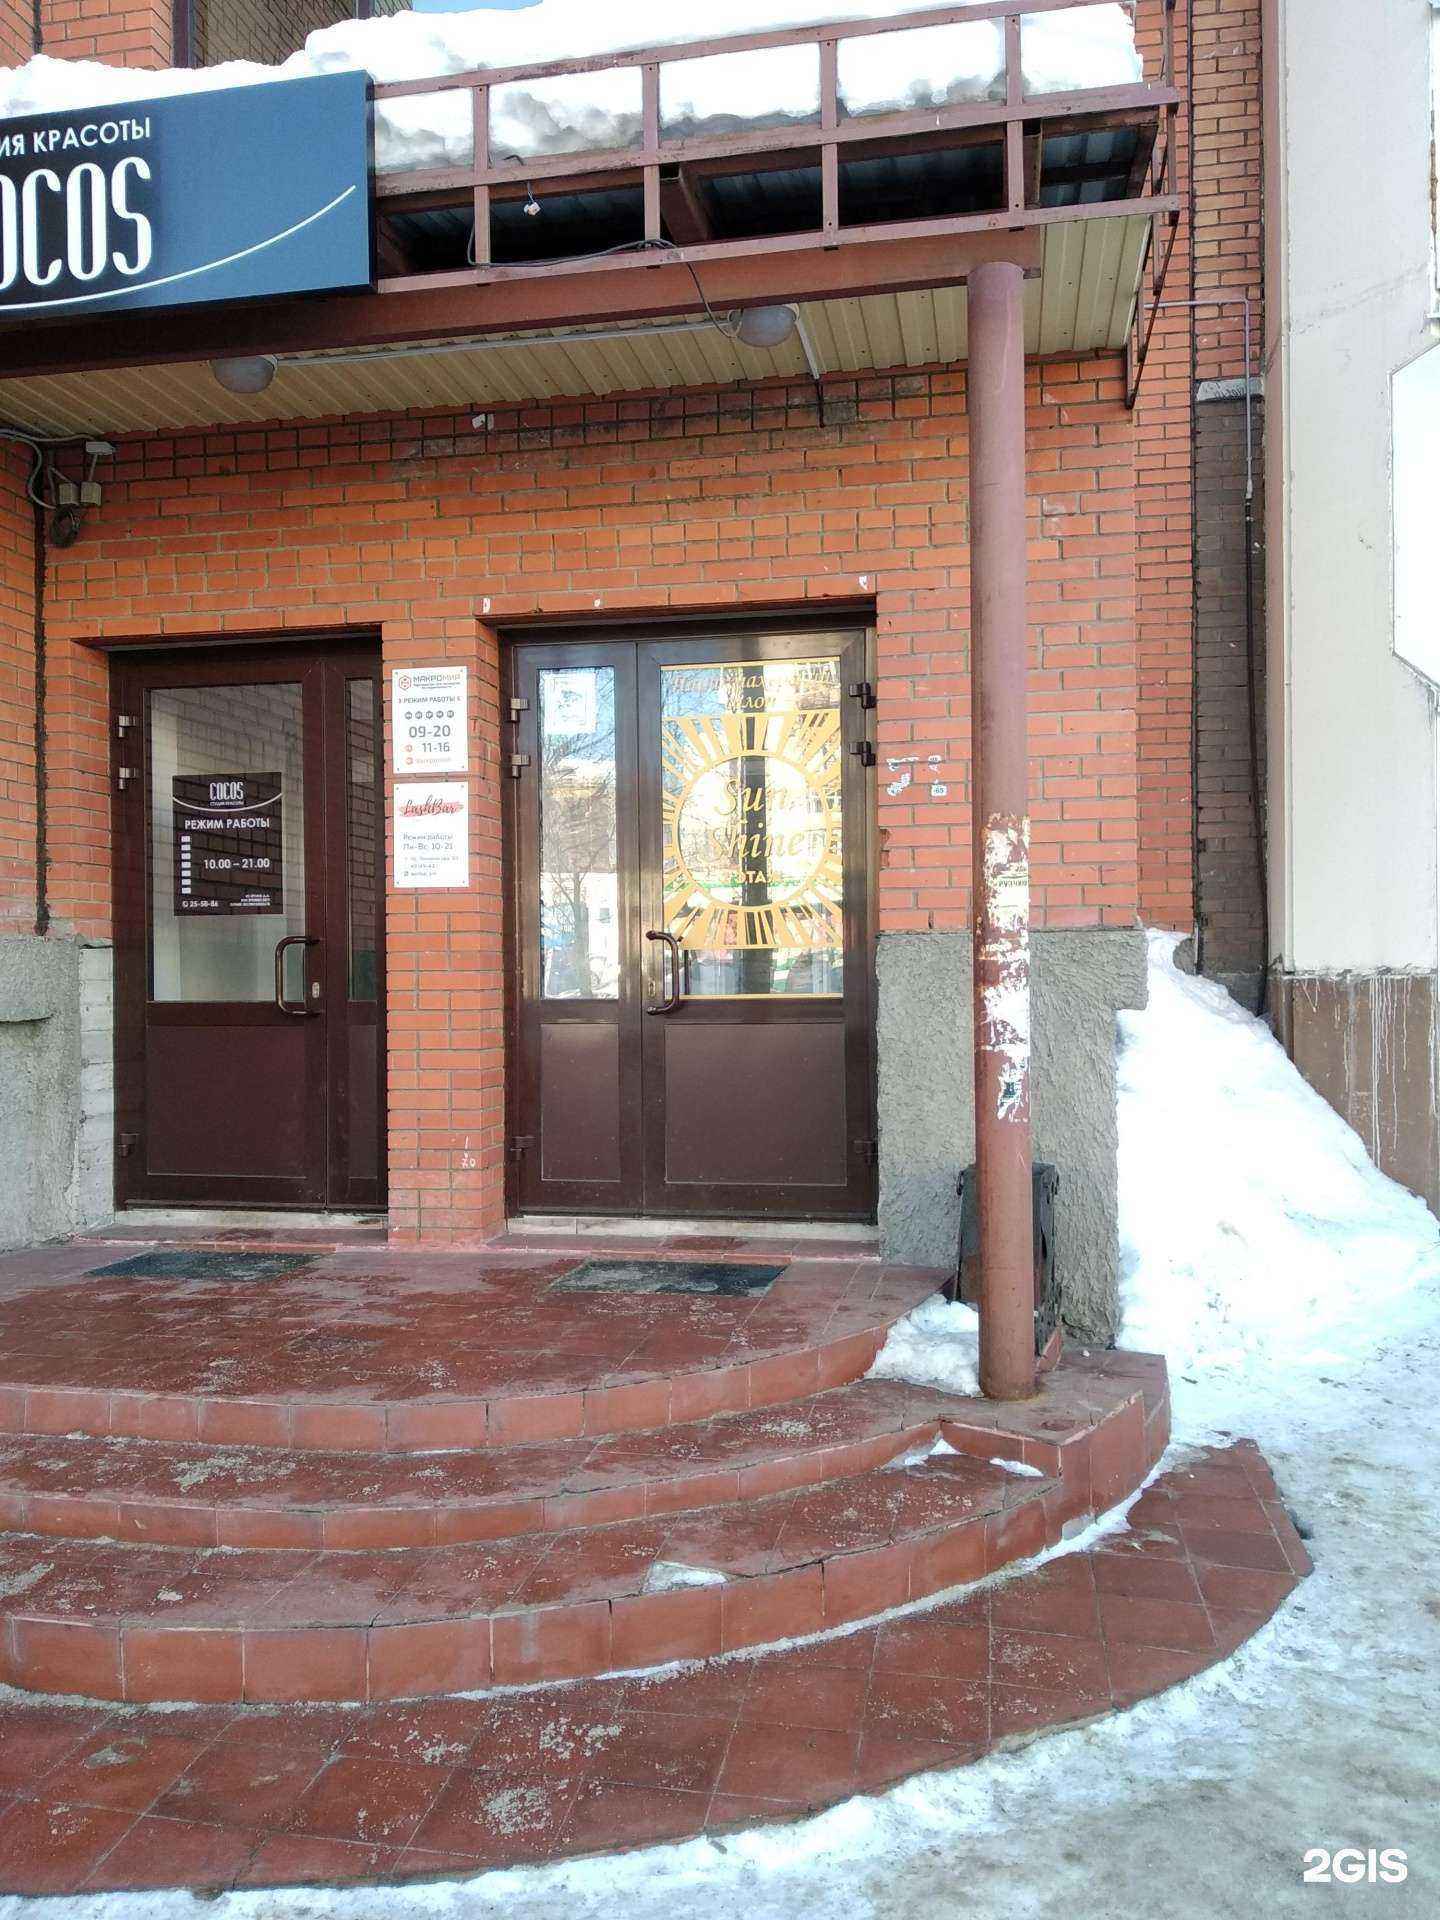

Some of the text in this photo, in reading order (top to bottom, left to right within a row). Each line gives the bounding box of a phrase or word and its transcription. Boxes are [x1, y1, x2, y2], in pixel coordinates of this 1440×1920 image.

[33, 117, 150, 153] КРАСОТЫ
[409, 725, 451, 738] 09-20
[422, 742, 450, 752] 11-16
[209, 781, 244, 801] COCOS
[184, 817, 270, 830] РЕЖИМ РАБОТЫ
[204, 859, 231, 869] 10.00
[242, 858, 270, 869] 21.00
